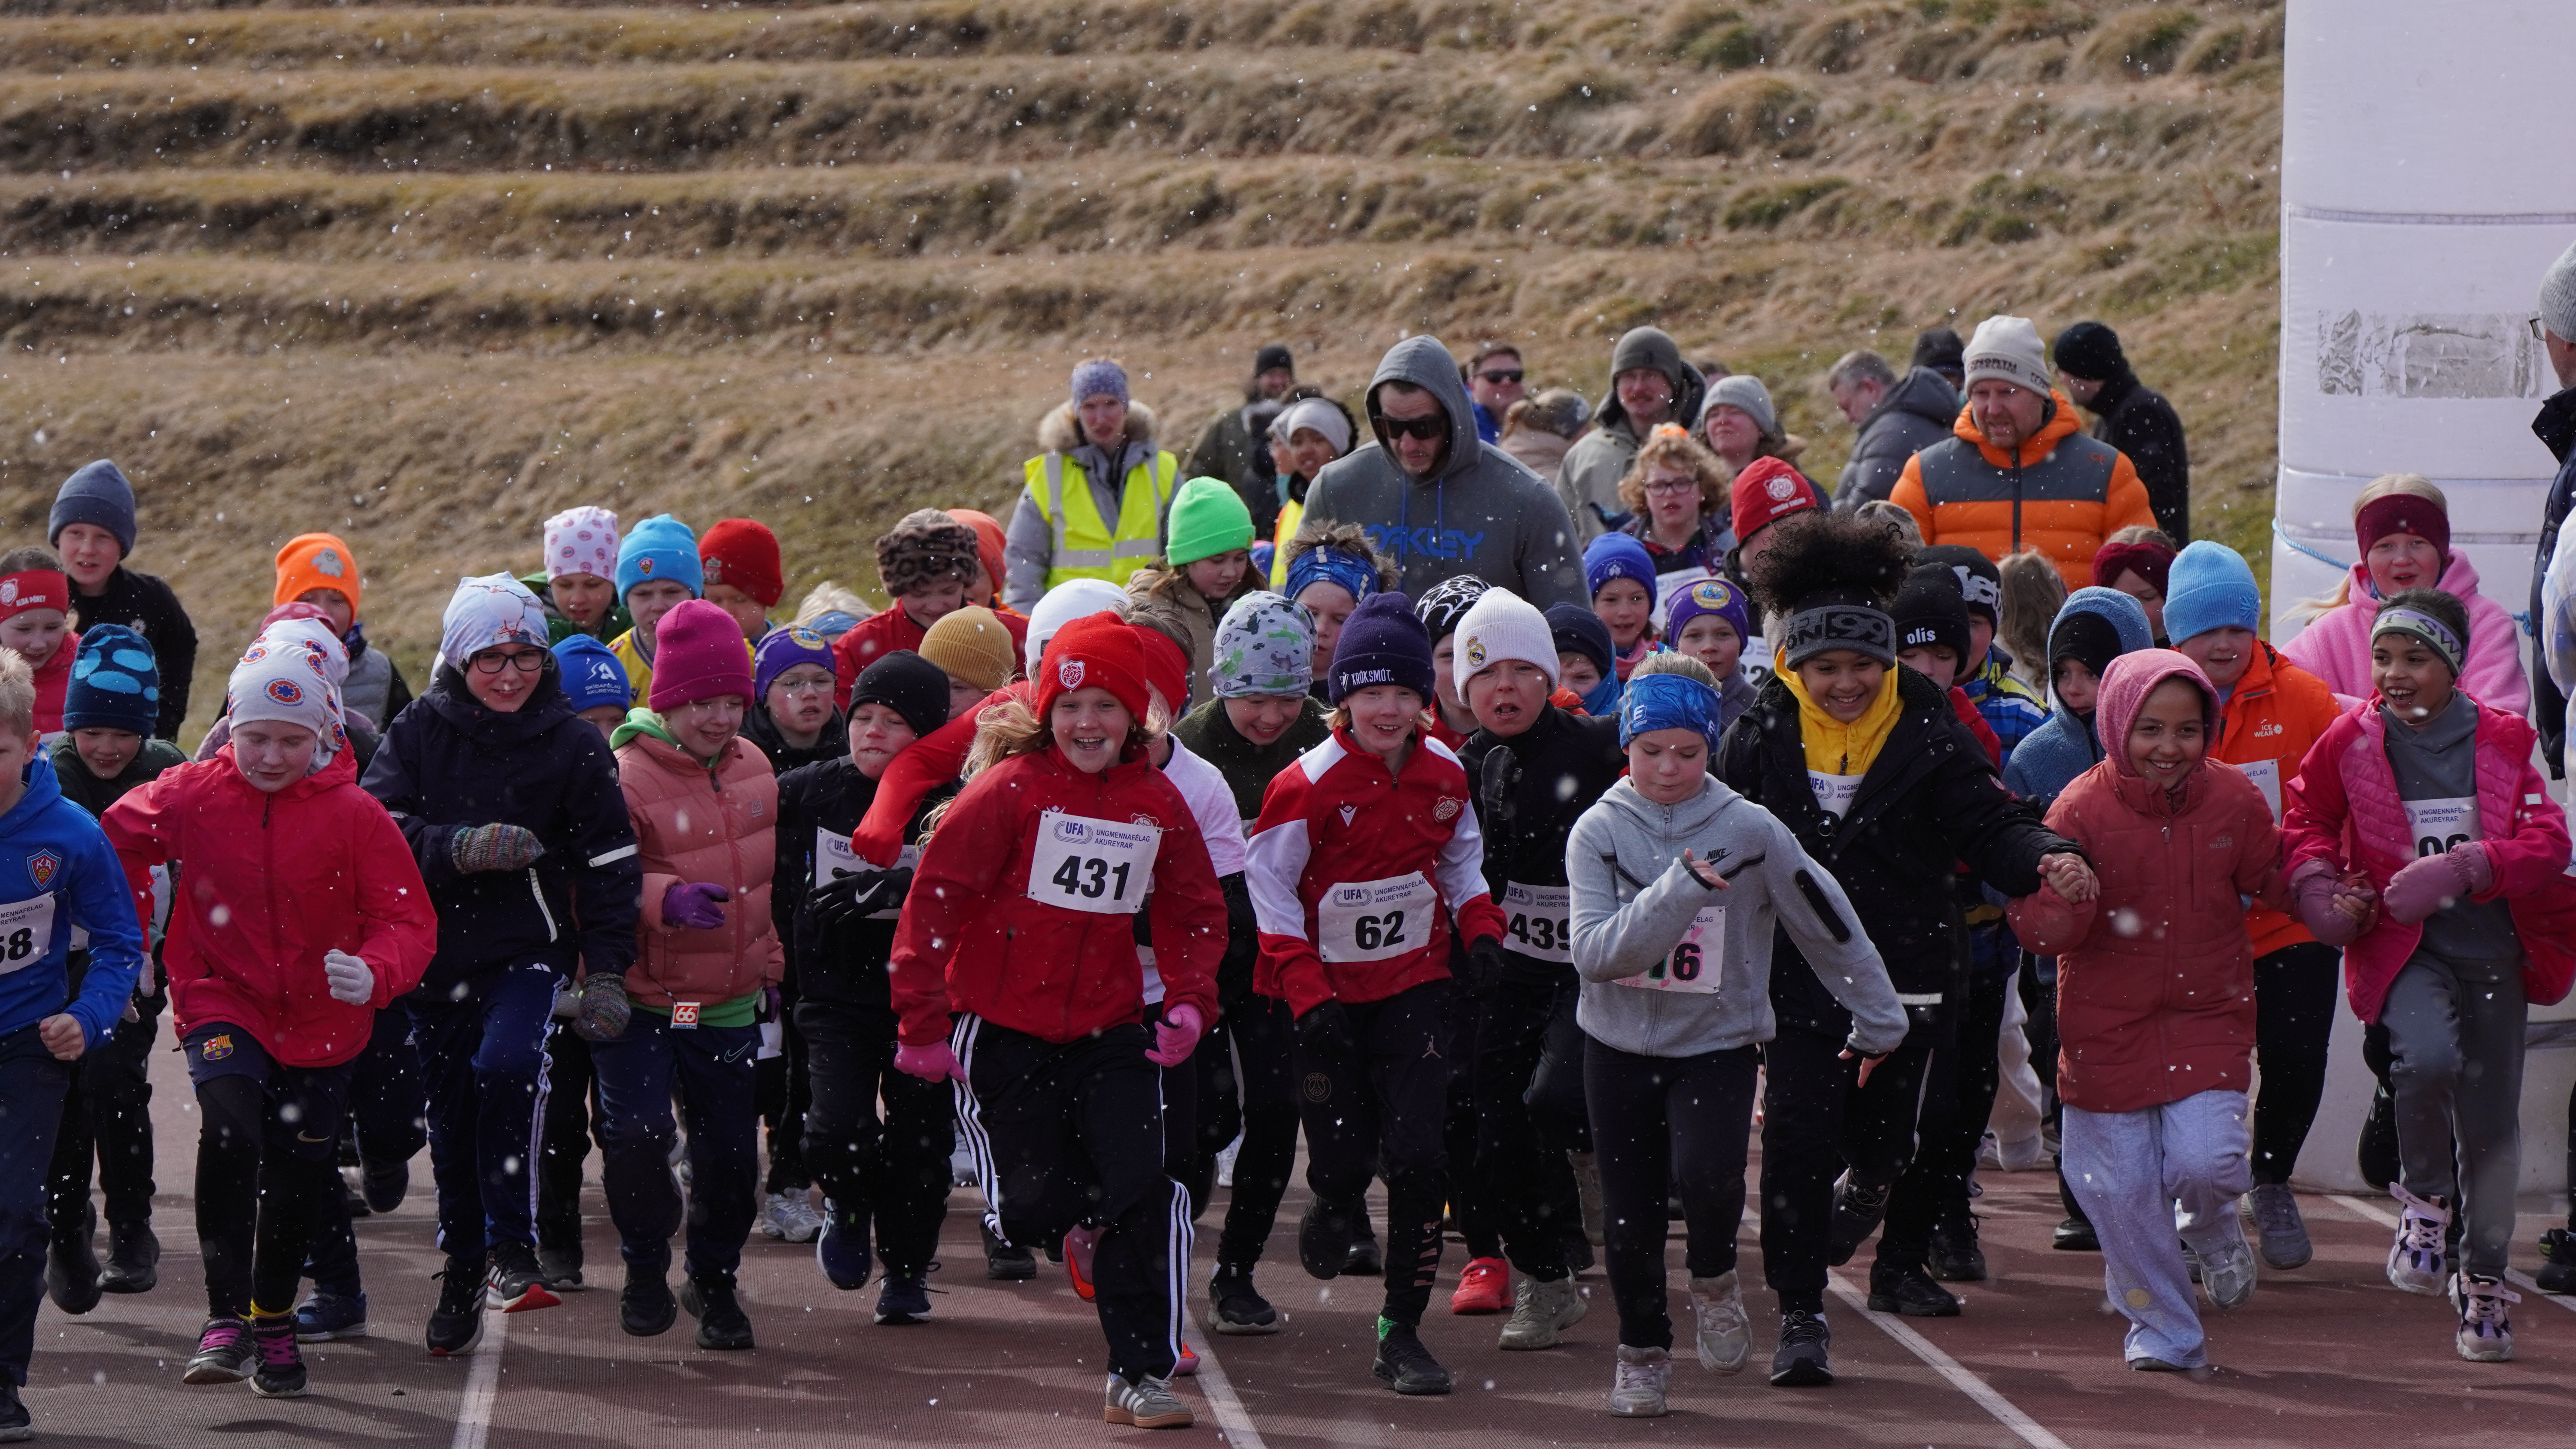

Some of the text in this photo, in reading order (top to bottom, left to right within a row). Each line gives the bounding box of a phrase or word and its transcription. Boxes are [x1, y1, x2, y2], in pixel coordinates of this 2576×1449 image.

[1364, 524, 1484, 558] OAKLEY
[1907, 627, 1936, 644] olis
[1351, 667, 1391, 686] KRÓKSMÓT
[1065, 822, 1151, 842] UFA UNGMENNAFÉLAG
[834, 840, 848, 853] UFA
[1094, 838, 1133, 849] AKUREYRAR
[1707, 848, 1726, 859] NIKE
[1052, 855, 1131, 900] 431
[1344, 878, 1426, 900] UFA UNGMENNAFÉLAG
[1375, 891, 1412, 903] AKUREYRAR
[1508, 886, 1525, 899] UFA
[0, 903, 43, 919] MENNAFÉLAG
[0, 914, 26, 925] REYRAR
[1355, 910, 1405, 950] 62
[1413, 1220, 1441, 1287] PARIS
[207, 1319, 244, 1327] SKECHERS
